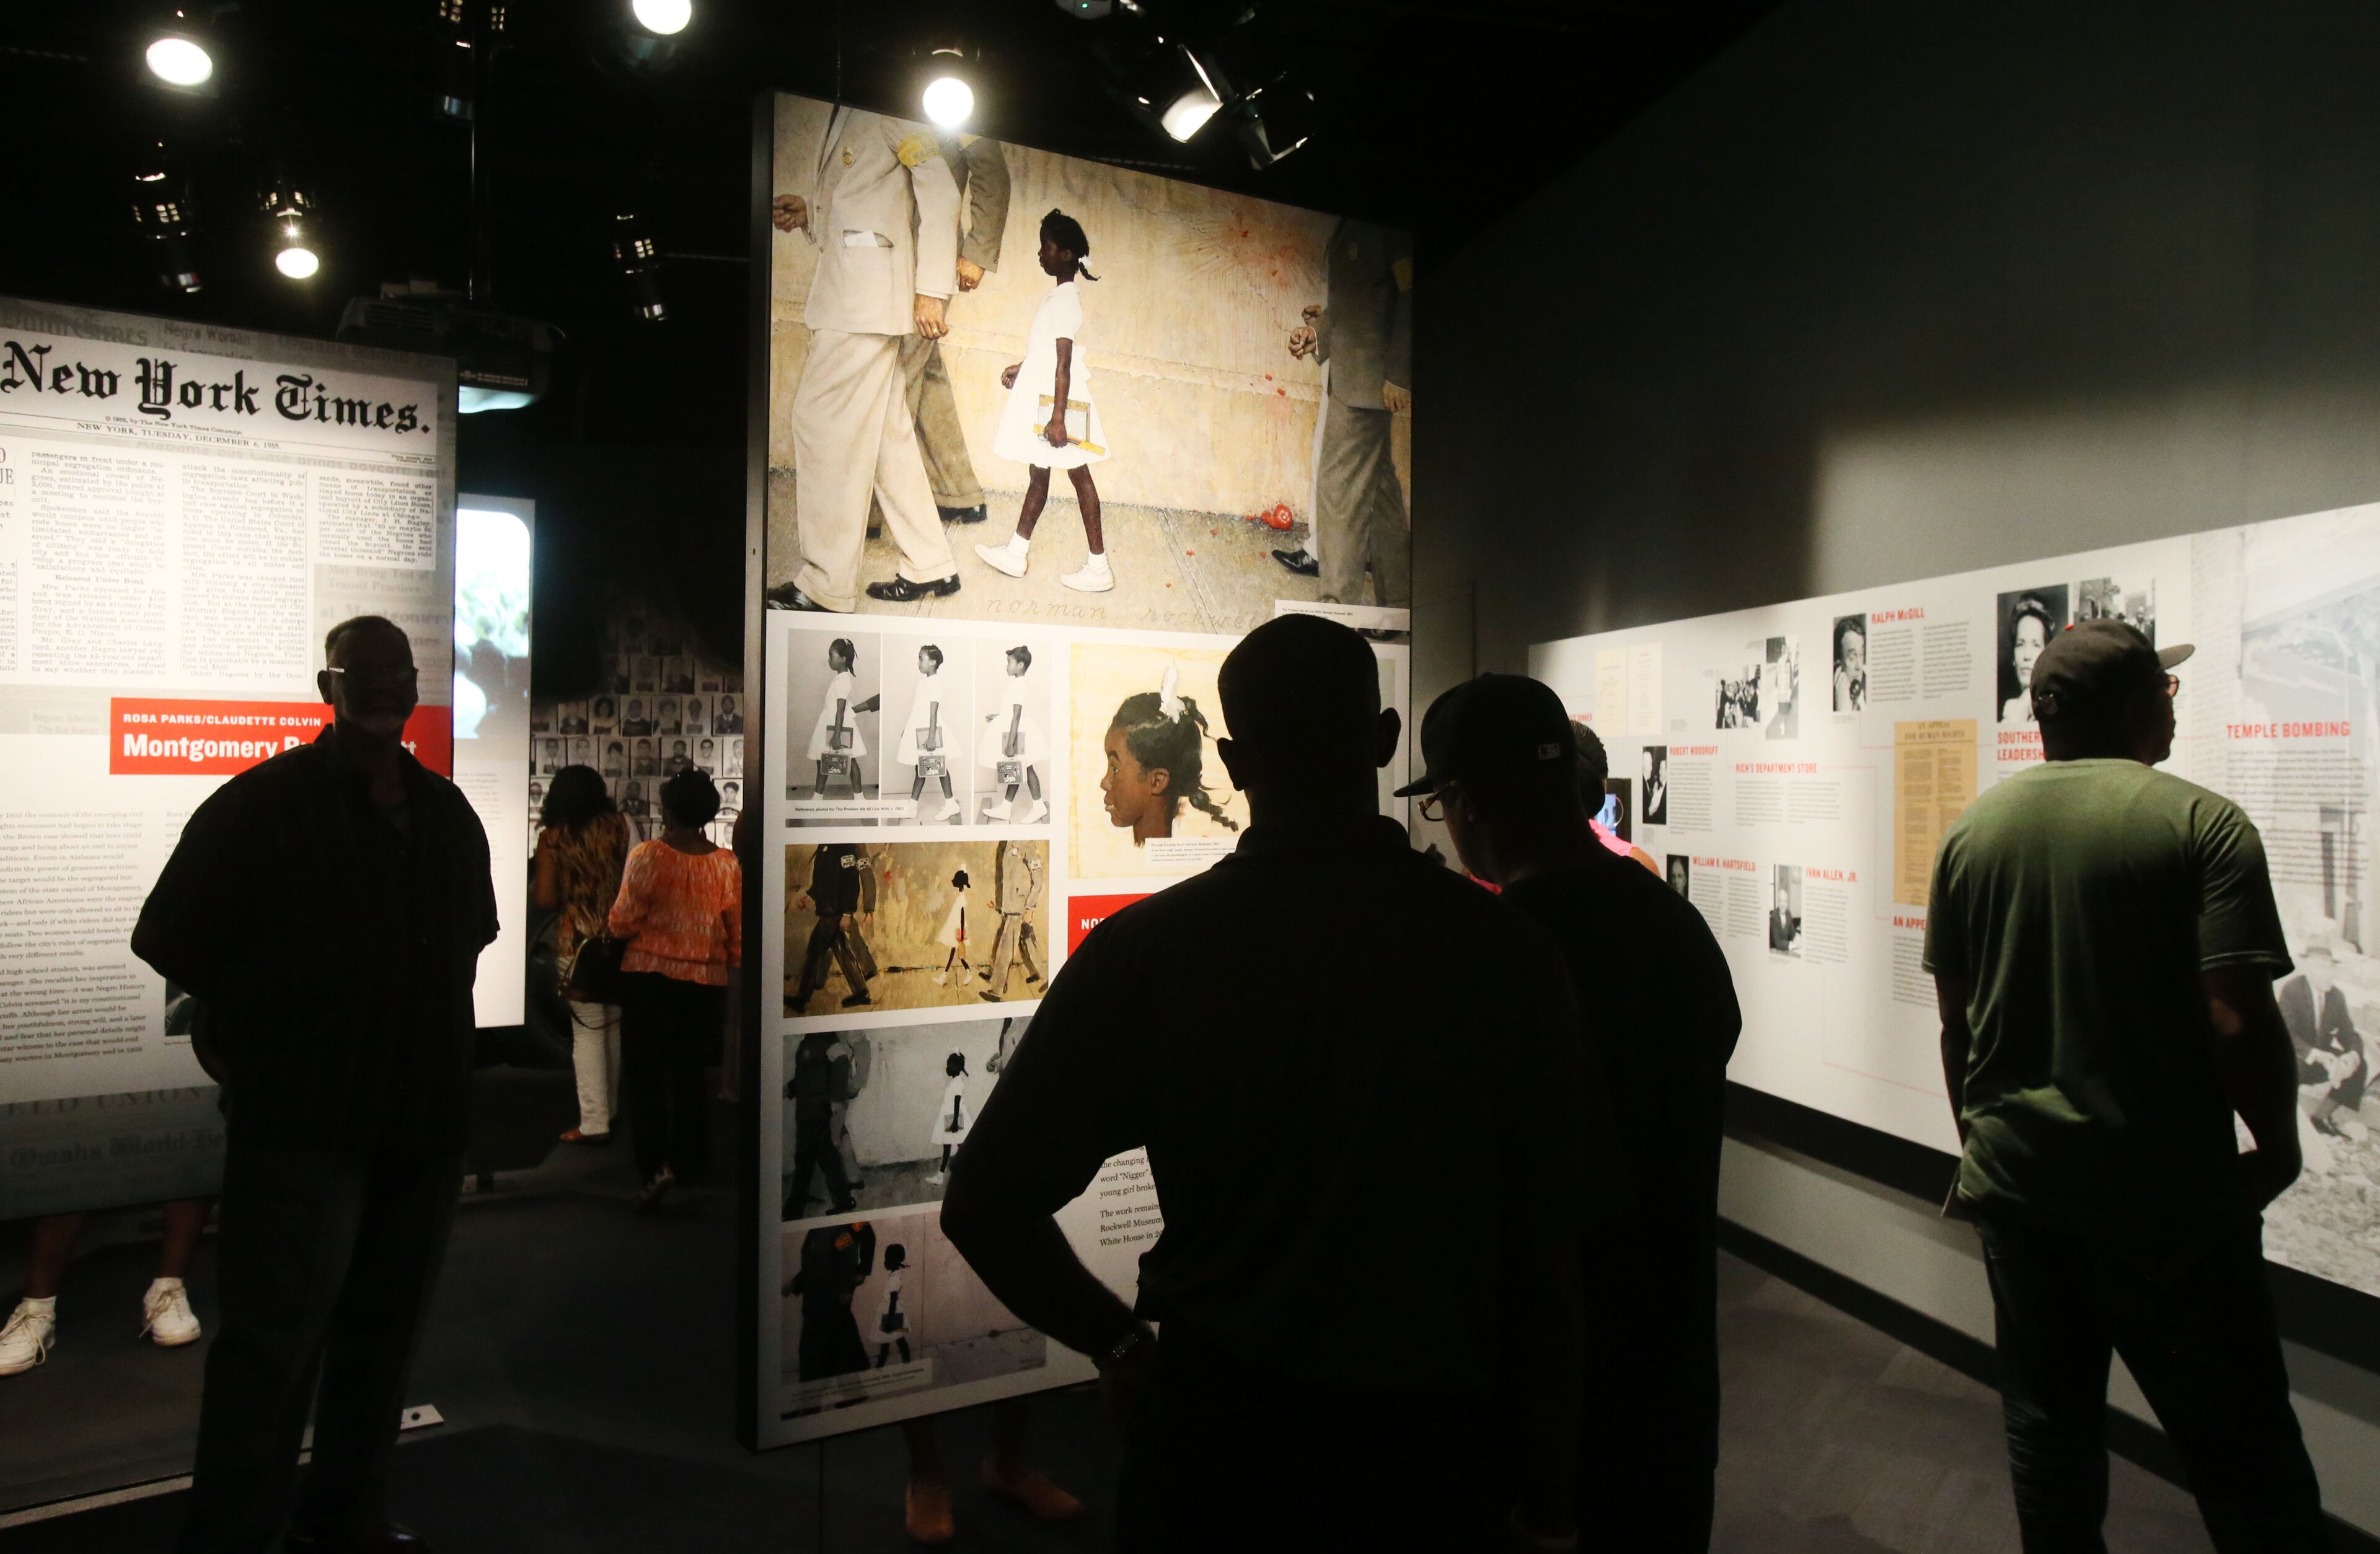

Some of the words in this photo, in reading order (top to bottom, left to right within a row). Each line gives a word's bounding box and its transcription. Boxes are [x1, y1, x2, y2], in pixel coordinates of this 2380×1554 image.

[0, 340, 122, 398] New
[135, 357, 261, 421] York
[275, 374, 430, 434] Times.
[77, 422, 100, 431] NEW
[107, 426, 138, 436] YORK,
[141, 429, 192, 441] TUESDAY,
[195, 435, 249, 447] DECEMBER
[32, 452, 77, 462] passengers
[32, 459, 59, 468] nicipal
[64, 462, 112, 472] segregation
[117, 465, 157, 474] ordinance.
[60, 468, 99, 477] emotional
[231, 468, 292, 480] constitutionality
[60, 476, 99, 484] estimated
[131, 481, 153, 489] police
[42, 489, 74, 499] meeting
[92, 493, 126, 501] continue
[148, 497, 165, 505] boy-
[403, 556, 417, 564] day.
[986, 597, 1108, 620] norman
[1872, 612, 1895, 624] RALPH
[1897, 607, 1924, 621] McGILL
[123, 714, 157, 725] ROSA
[161, 714, 276, 726] PARKS/CLAUDETTE
[280, 716, 321, 727] COLVIN
[2227, 723, 2278, 738] TEMPLE
[2283, 721, 2350, 737] BOMBING
[1998, 731, 2042, 744] SOUTHER
[124, 733, 278, 762] Montgomery
[1670, 746, 1688, 756] ROBERT
[1691, 745, 1718, 755] WOODRUFF
[1998, 748, 2047, 761] LEADERSH
[1756, 763, 1795, 773] DEPARTMENT
[1797, 763, 1817, 773] STORE
[1693, 856, 1714, 866] WILLIAM
[1723, 859, 1756, 871] HARTSFIELD
[1806, 867, 1820, 879] IVAN
[1894, 916, 1903, 926] AN
[1906, 917, 1926, 931] APPE
[7, 968, 23, 977] high
[50, 965, 80, 973] student,
[97, 962, 126, 970] arrested
[1113, 1157, 1144, 1166] changing
[1101, 1173, 1117, 1182] word
[1100, 1188, 1121, 1199] young
[1123, 1185, 1135, 1195] girl
[1116, 1206, 1132, 1214] work
[1101, 1221, 1131, 1232] Rockwell
[1134, 1218, 1162, 1226] Museum
[1100, 1237, 1121, 1245] White
